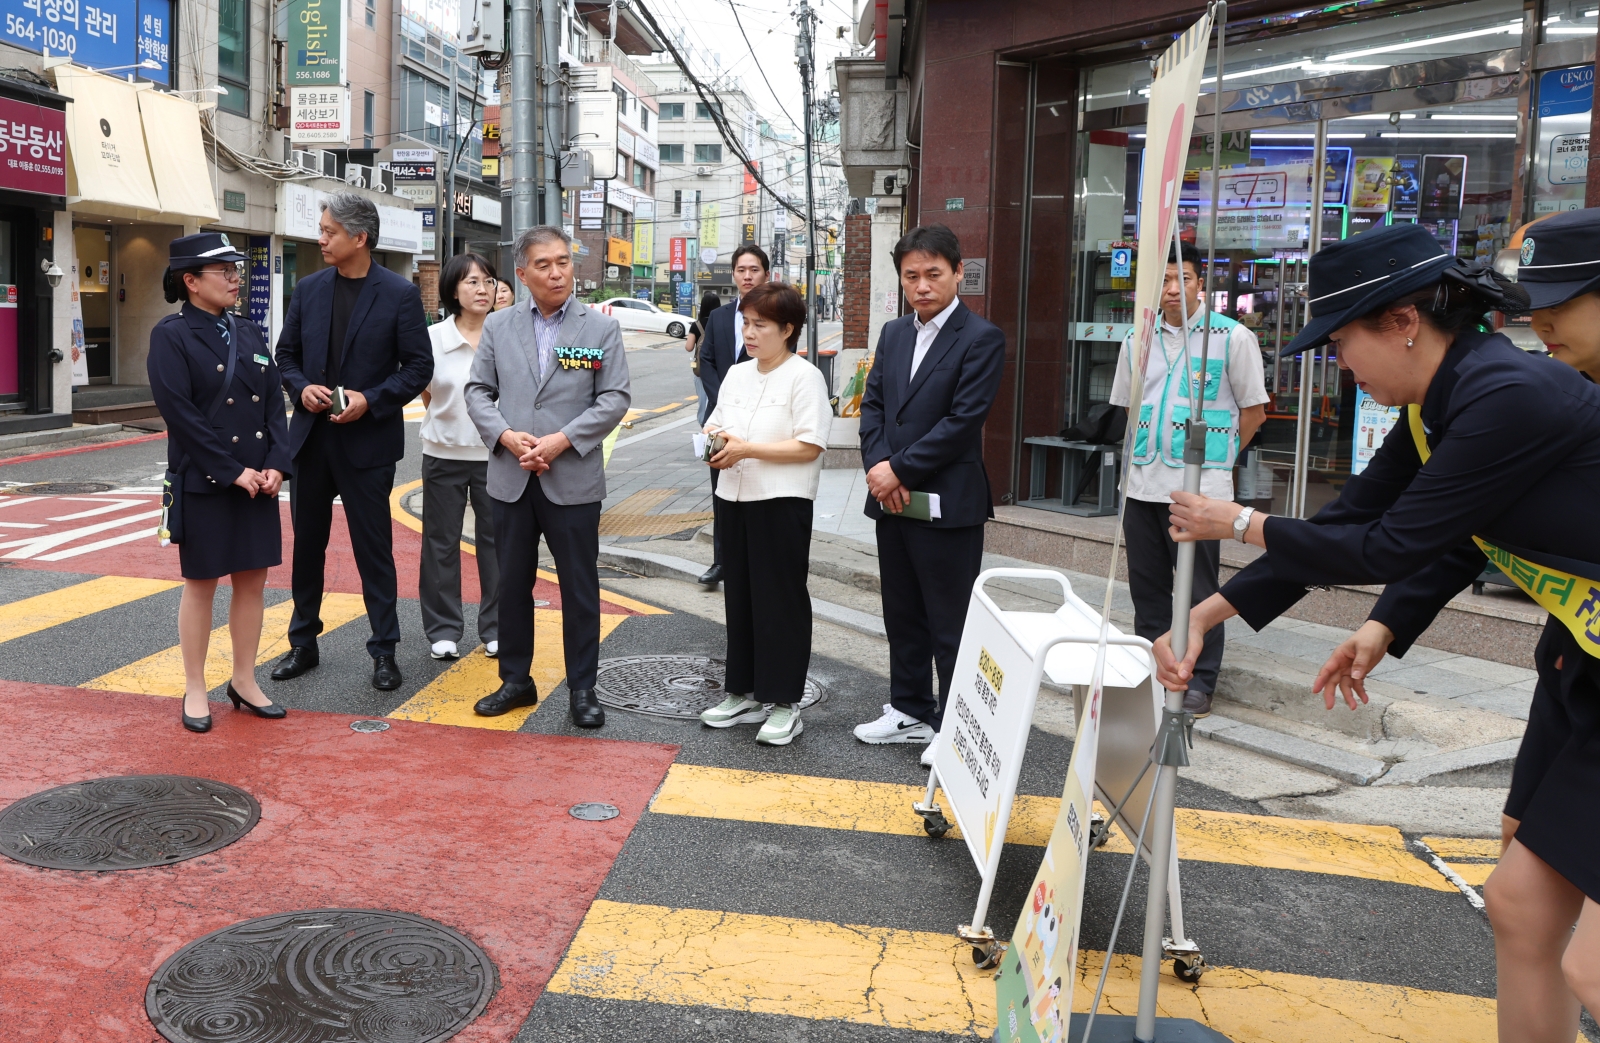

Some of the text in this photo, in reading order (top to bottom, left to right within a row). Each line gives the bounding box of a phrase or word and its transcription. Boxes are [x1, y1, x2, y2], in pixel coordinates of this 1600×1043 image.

[84, 5, 117, 44] 관리
[6, 13, 77, 54] 564-1030
[137, 34, 169, 63] 수학학원
[320, 57, 339, 65] Clinic
[295, 71, 331, 79] 556.1686
[1560, 69, 1593, 84] CESCO
[297, 93, 339, 105] 물음표로
[297, 108, 339, 120] 세상보기
[7, 158, 18, 168] 대표
[417, 166, 435, 177] 수학
[401, 188, 432, 196] SOHO
[1256, 214, 1283, 223] 없습니다
[553, 346, 605, 360] 강남구청장
[558, 358, 592, 370] 김현기
